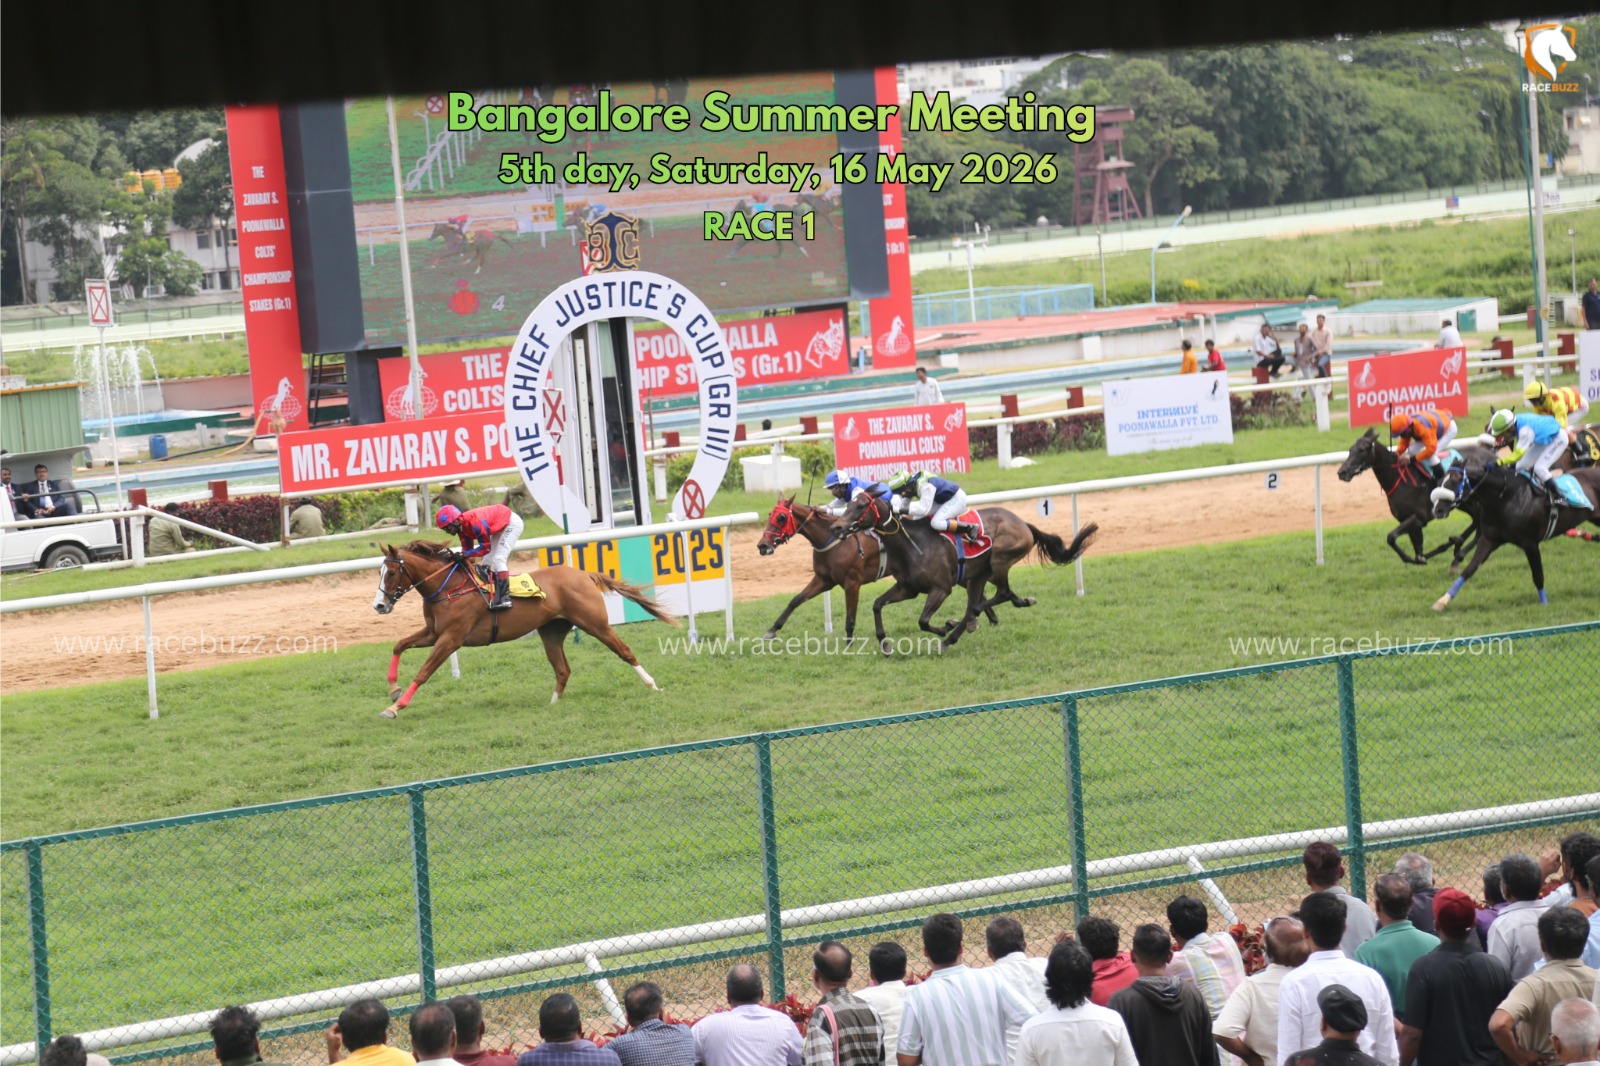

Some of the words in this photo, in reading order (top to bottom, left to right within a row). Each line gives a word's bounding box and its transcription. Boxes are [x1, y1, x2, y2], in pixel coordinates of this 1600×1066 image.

[252, 166, 265, 178] THE
[243, 193, 271, 206] ZAVARAY
[242, 218, 285, 233] POONAWALLA
[243, 270, 292, 286] CHAMPIONSHIP
[249, 298, 273, 312] STAKES
[491, 295, 505, 311] 4
[555, 281, 687, 328] JUSTICE'S
[686, 314, 725, 369] CUP
[462, 353, 503, 381] THE
[513, 324, 550, 410] CHIEF
[751, 350, 802, 379] (Gr.1)
[1357, 380, 1462, 408] POONAWALLA
[868, 417, 884, 436] THE
[886, 414, 923, 434] ZAVARAY
[925, 413, 934, 431] S.
[1119, 418, 1178, 433] POONAWALLA
[1181, 416, 1197, 427] PVT
[291, 443, 339, 482] MR.
[344, 429, 448, 477] ZAVARAY
[454, 427, 478, 464] S.
[515, 423, 549, 481] THE
[858, 437, 918, 460] POONAWALLA
[1268, 473, 1277, 488] 2
[1043, 499, 1049, 516] 1
[654, 527, 724, 575] 2025
